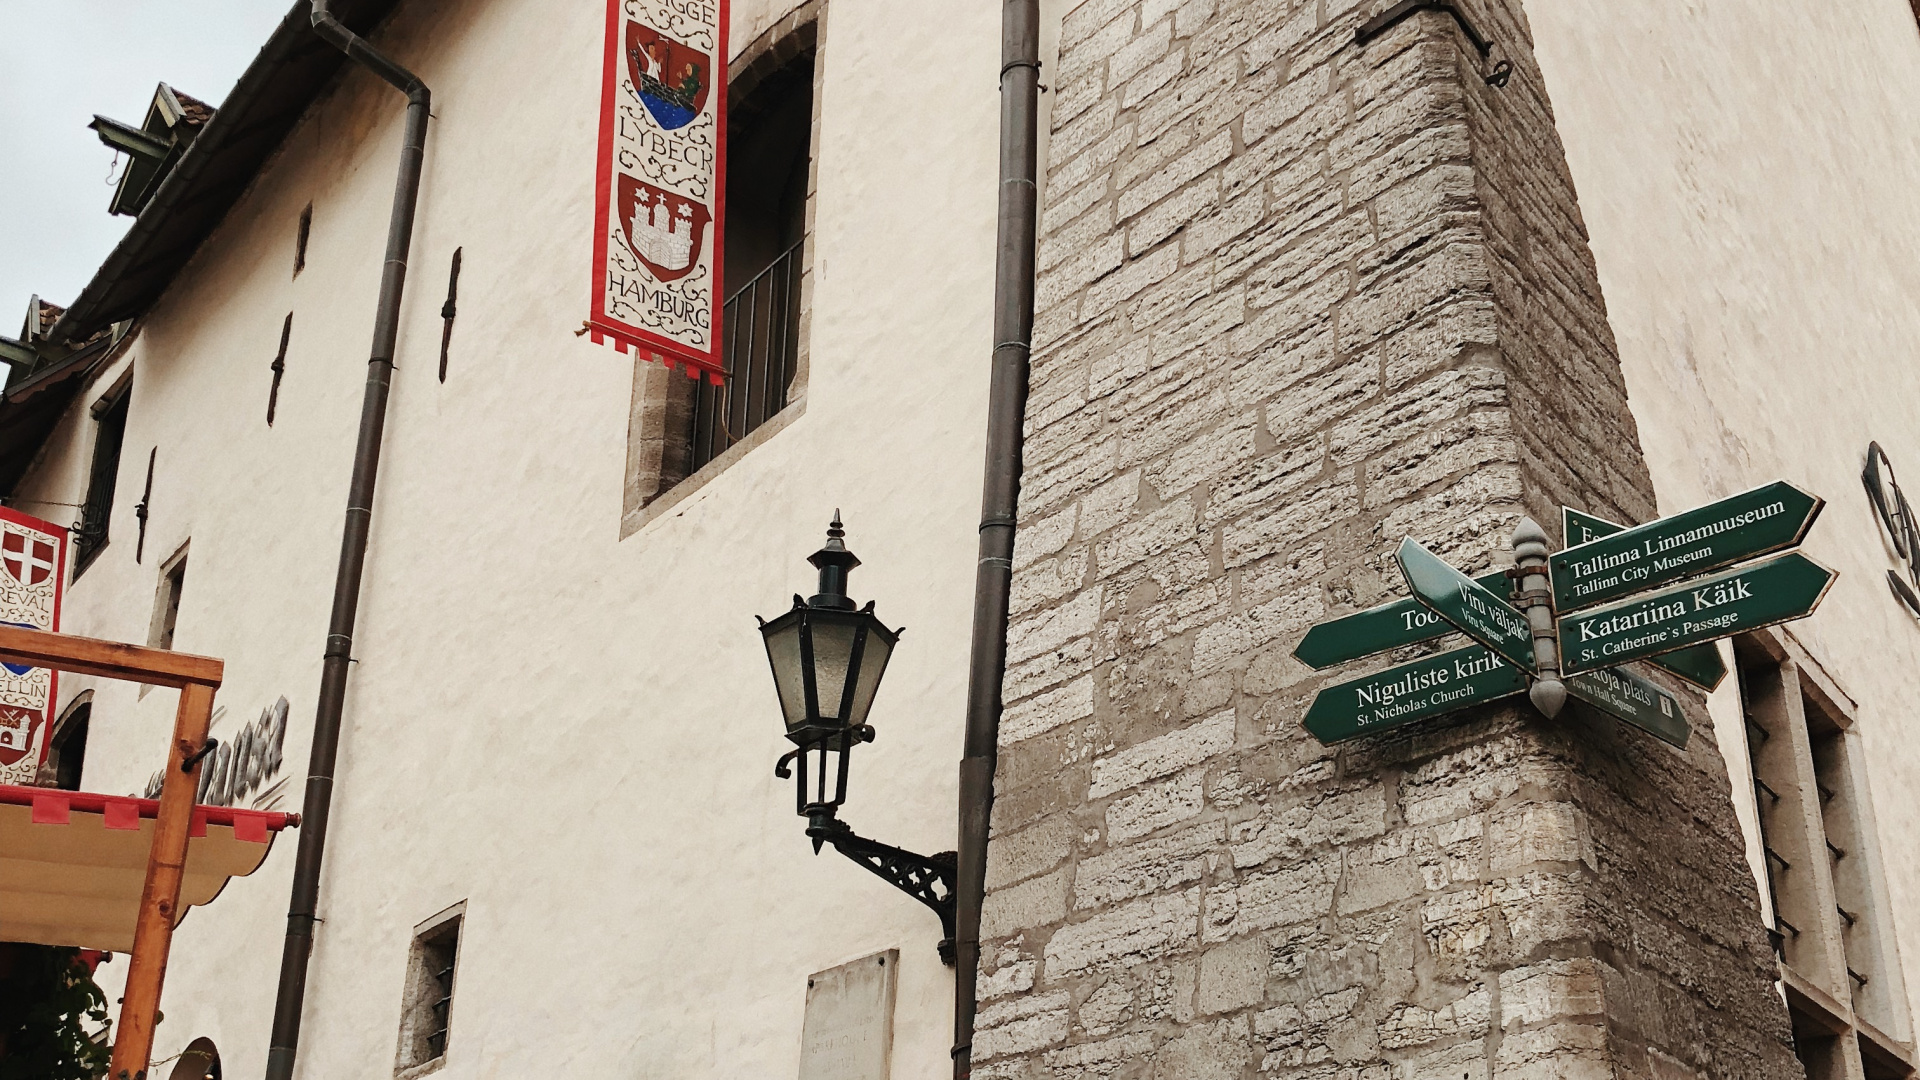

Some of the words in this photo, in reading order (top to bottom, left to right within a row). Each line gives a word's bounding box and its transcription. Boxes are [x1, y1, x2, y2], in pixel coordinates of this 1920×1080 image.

[620, 116, 713, 174] LYBECK
[608, 270, 710, 330] HAMBURG
[1570, 549, 1640, 580] Tallinna
[1643, 501, 1786, 557] Linnamuuseum
[1573, 576, 1619, 598] Tallinn
[1622, 564, 1651, 582] City
[1654, 545, 1713, 573] Museum
[1401, 609, 1444, 631] Too
[1457, 580, 1487, 616] Viru
[1488, 604, 1525, 642] väljak
[1462, 608, 1479, 628] Viru
[1479, 621, 1505, 645] Square
[1578, 600, 1687, 643] Katariina
[1691, 578, 1753, 613] Käik
[1581, 648, 1599, 663] St.
[1683, 611, 1739, 637] Passage
[1355, 668, 1450, 709] Niguliste
[1454, 651, 1505, 679] kirik
[1357, 713, 1373, 727] St.
[1375, 700, 1427, 721] Nicholas
[1430, 684, 1475, 706] Church
[1593, 685, 1611, 703] Hall
[1611, 694, 1638, 716] Square
[1622, 679, 1652, 706] plats
